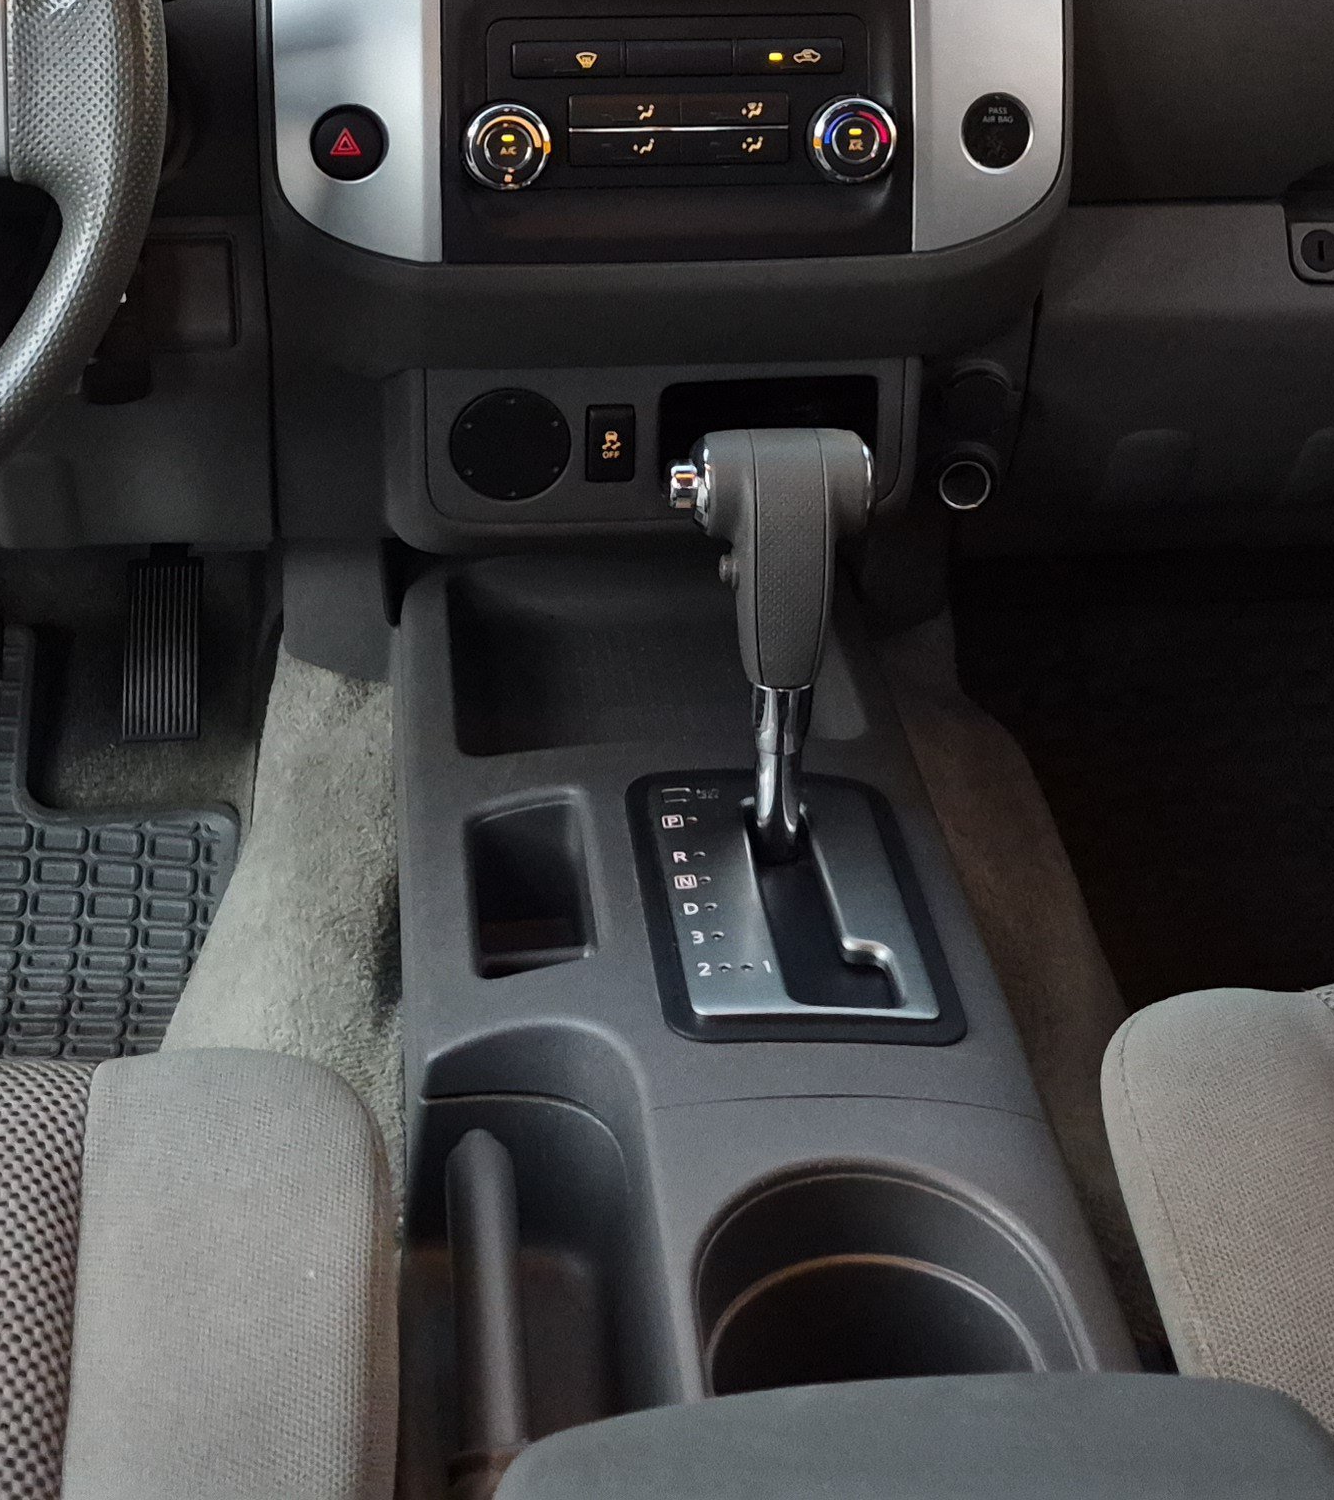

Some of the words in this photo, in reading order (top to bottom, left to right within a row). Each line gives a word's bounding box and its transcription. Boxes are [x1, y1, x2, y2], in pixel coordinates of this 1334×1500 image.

[500, 146, 517, 155] A/C
[602, 450, 620, 459] OFF
[673, 851, 688, 863] R
[683, 902, 699, 915] D
[691, 931, 705, 945] 3
[697, 962, 712, 977] 2
[762, 960, 772, 974] 1
